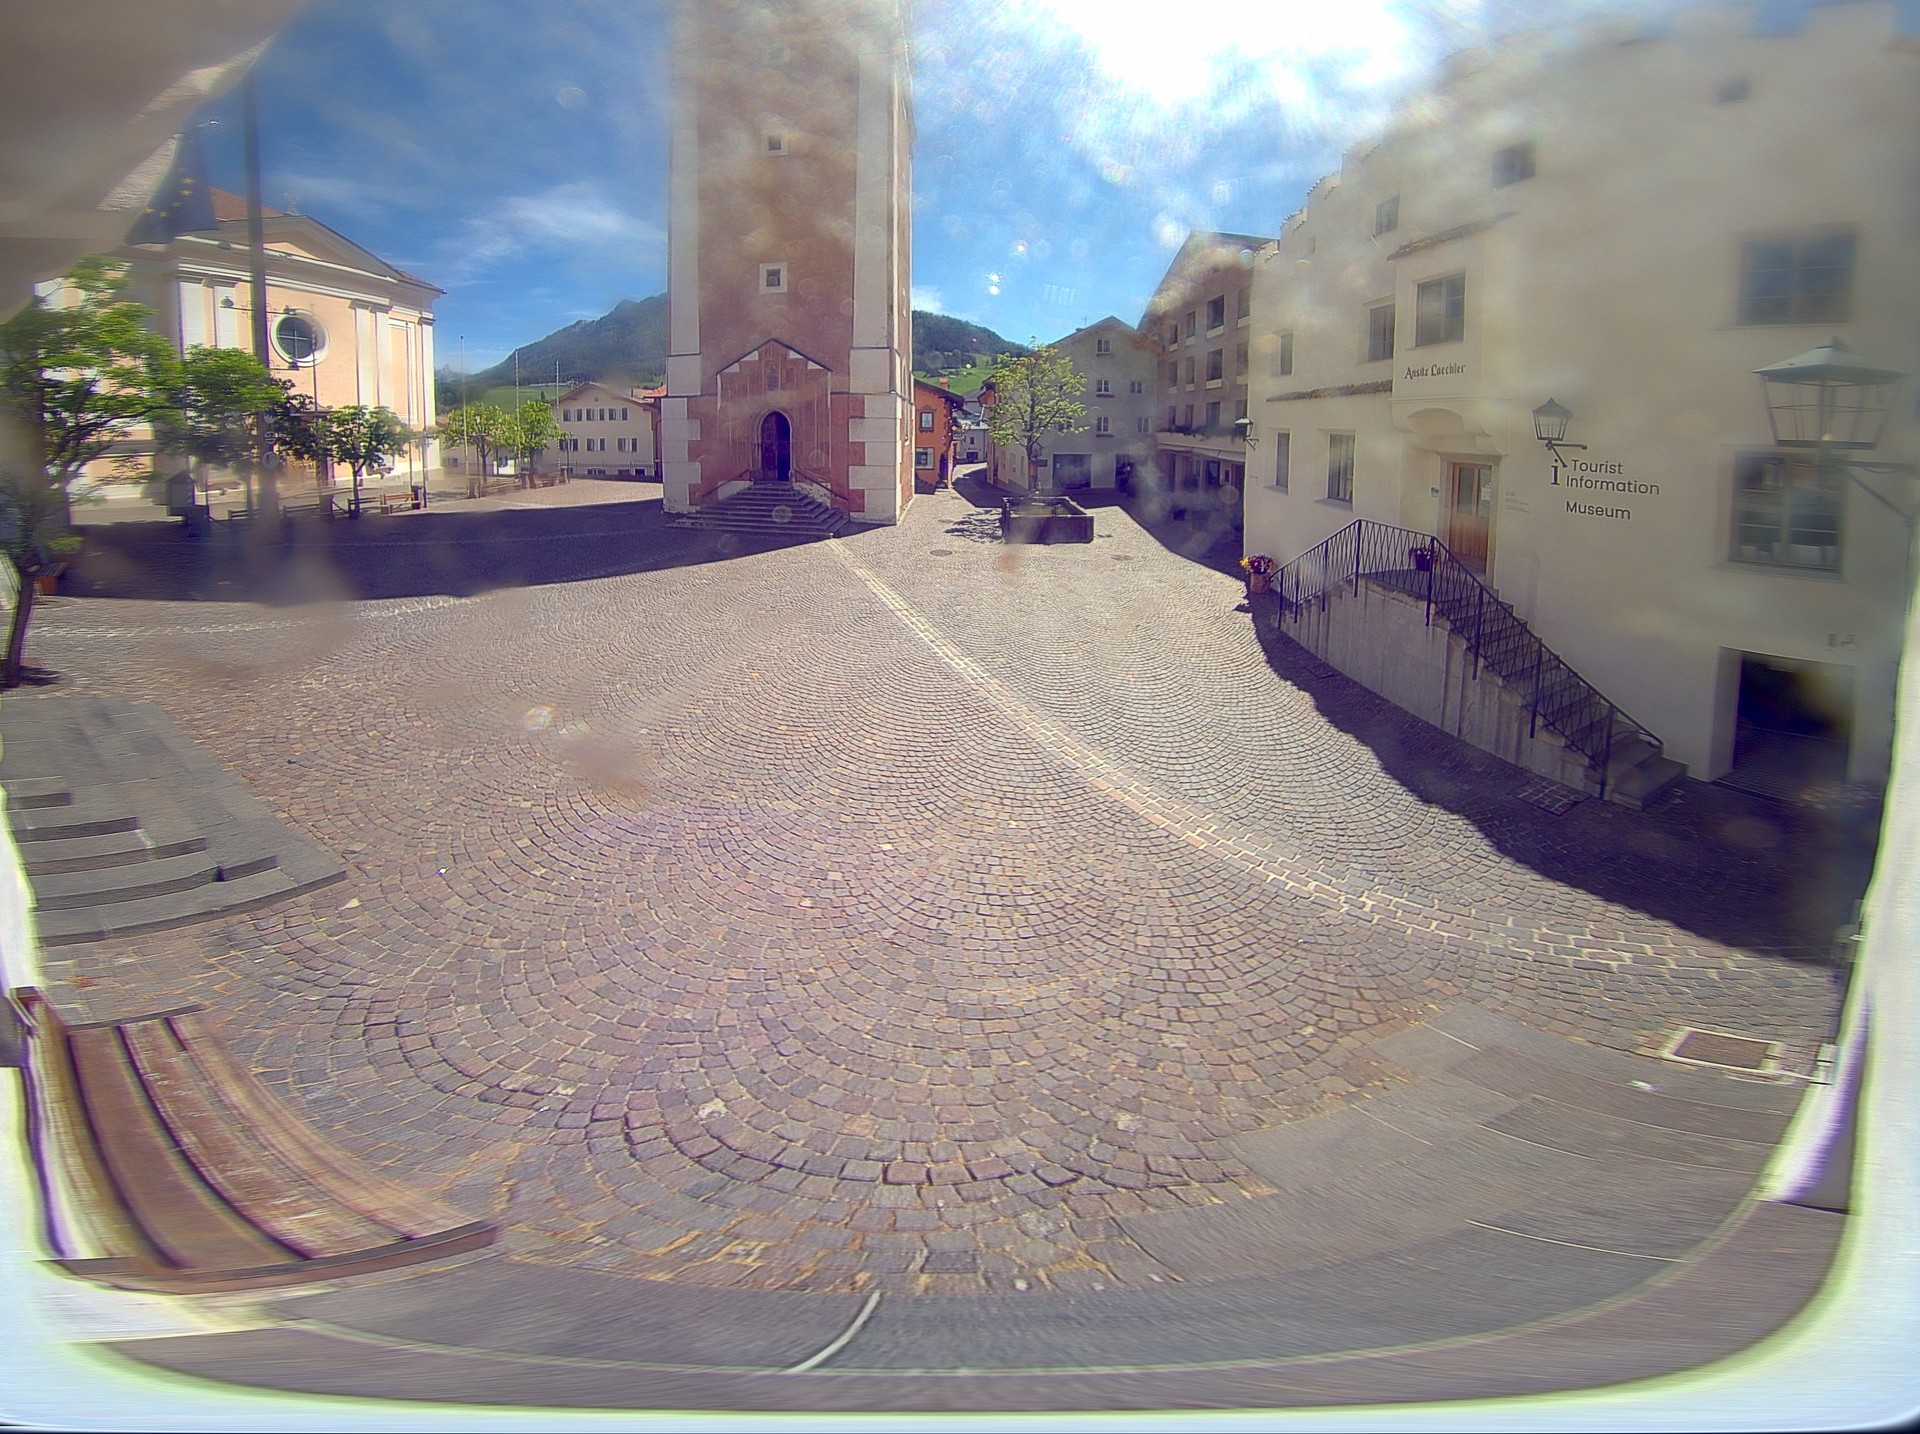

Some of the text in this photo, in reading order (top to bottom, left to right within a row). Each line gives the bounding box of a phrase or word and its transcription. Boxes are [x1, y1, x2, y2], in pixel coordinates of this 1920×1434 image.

[1430, 363, 1466, 376] Laechler
[1571, 459, 1624, 475] Tourist
[1566, 474, 1660, 495] Information
[1566, 500, 1631, 520] Museum
